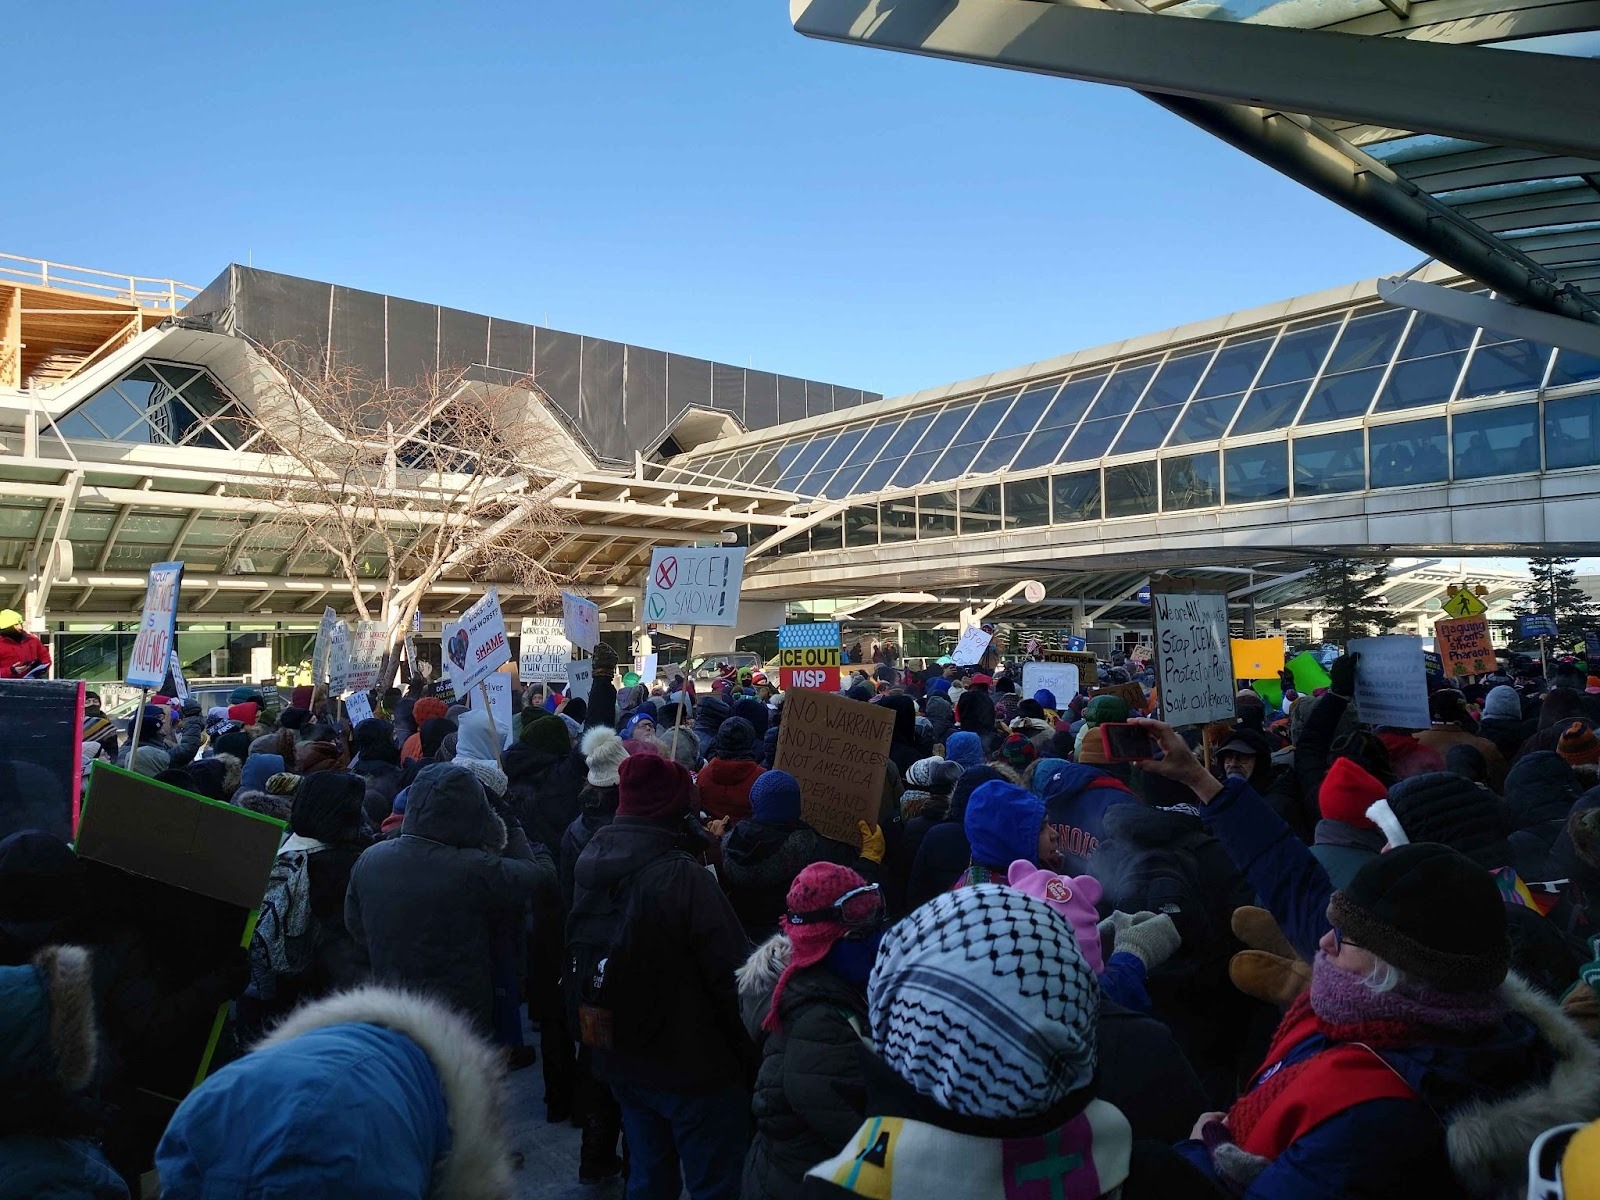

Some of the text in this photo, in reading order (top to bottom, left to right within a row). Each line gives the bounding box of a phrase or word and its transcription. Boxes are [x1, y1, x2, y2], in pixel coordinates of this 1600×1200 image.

[679, 556, 729, 588] ICE!
[671, 590, 726, 616] SNOW!
[1155, 595, 1174, 621] We
[964, 627, 988, 648] Stop
[1441, 622, 1485, 635] Plaguing
[1444, 631, 1485, 644] Tyrants
[475, 632, 505, 660] SHAME
[634, 639, 640, 653] 2
[1161, 629, 1190, 658] Stop
[1190, 625, 1206, 655] ICE
[549, 654, 562, 665] THE
[780, 648, 839, 666] ICE OUT
[1449, 647, 1491, 661] Pharaoh
[542, 663, 568, 674] CITIES
[792, 669, 827, 688] MSP
[1165, 657, 1203, 684] Protect
[1165, 689, 1188, 713] Save
[809, 732, 841, 756] DUE
[779, 751, 873, 789] NOT AMERICA
[802, 778, 867, 812] DEMAND
[803, 799, 856, 828] DEMOCRA
